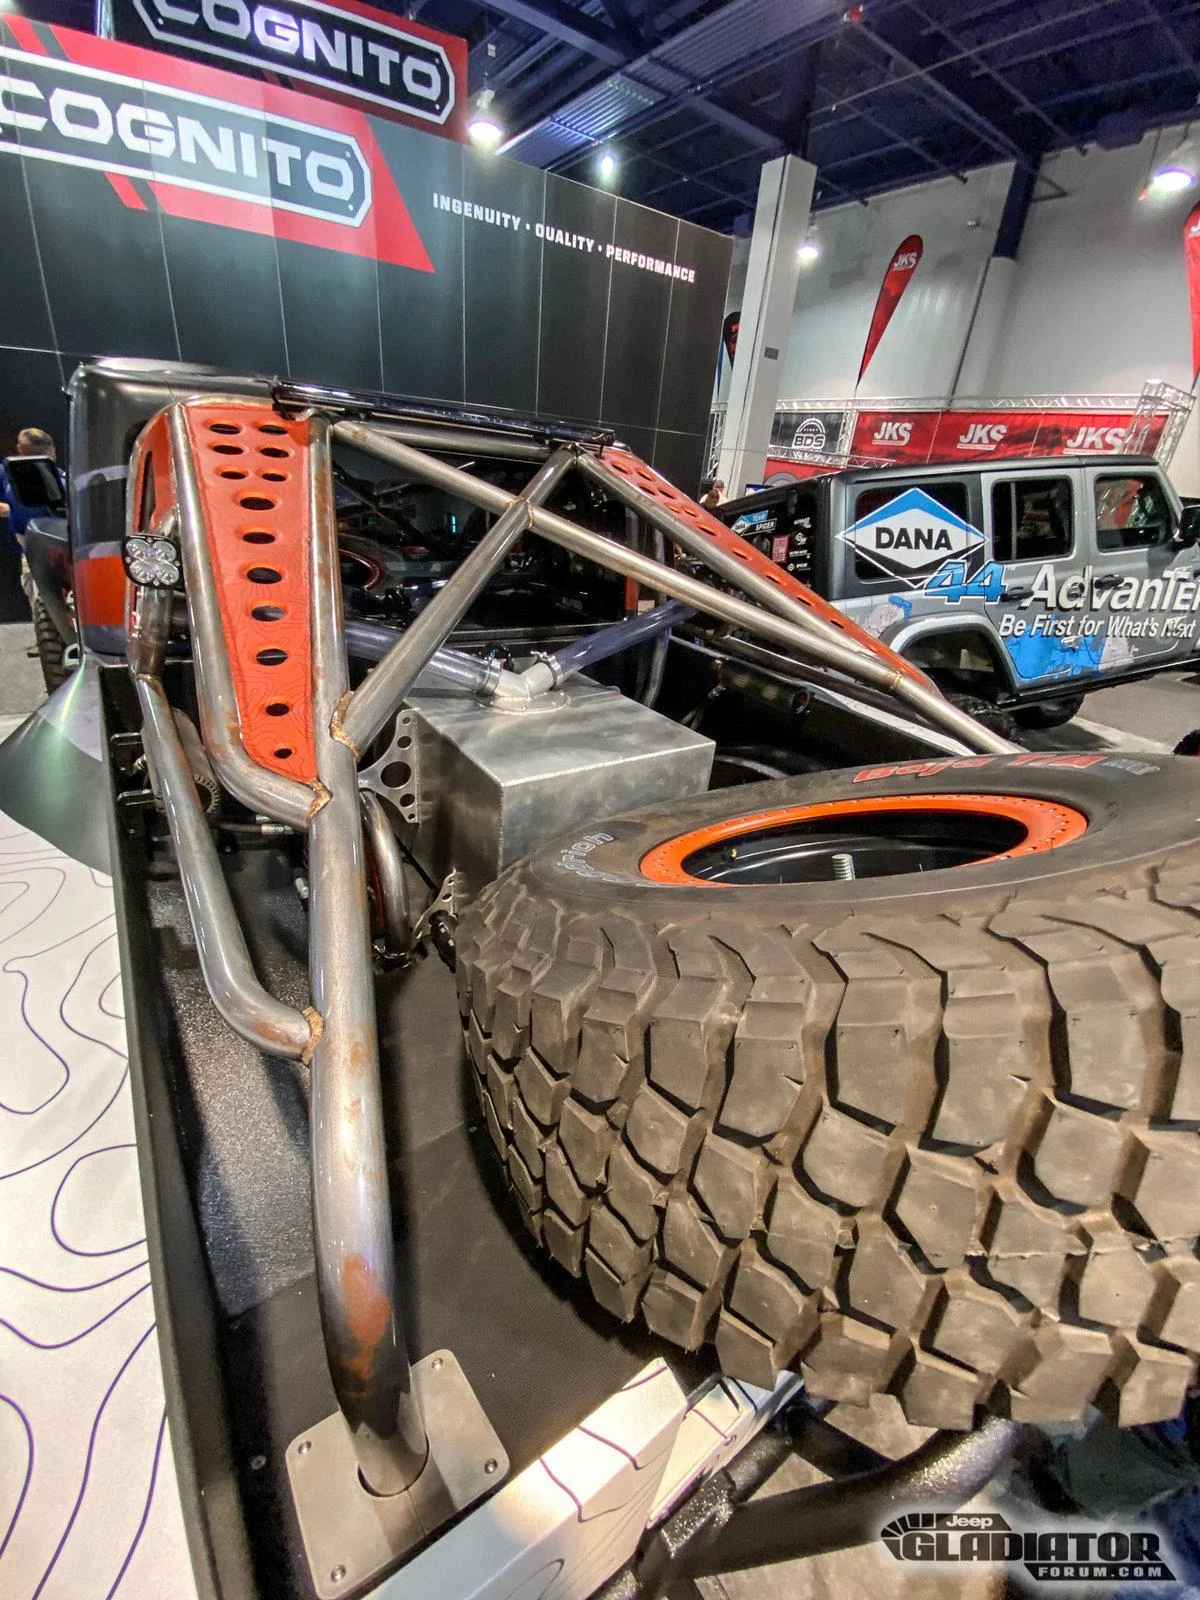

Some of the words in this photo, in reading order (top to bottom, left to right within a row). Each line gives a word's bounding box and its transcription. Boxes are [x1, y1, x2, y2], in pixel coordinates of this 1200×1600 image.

[0, 75, 355, 201] COGNITO
[432, 192, 522, 231] INGENUITY
[535, 223, 595, 252] QUALITY
[606, 244, 695, 283] PERFORMANCE
[893, 252, 918, 269] JKS
[793, 434, 826, 449] BDS
[873, 421, 912, 446] JKS
[959, 423, 1007, 444] JKS
[1066, 426, 1126, 454] JKS
[755, 521, 775, 531] SPICER
[875, 526, 953, 550] DANA
[924, 559, 1007, 605] 44
[999, 614, 1026, 637] Be
[1030, 614, 1075, 637] First
[1077, 615, 1104, 637] for
[1107, 615, 1159, 637] What's
